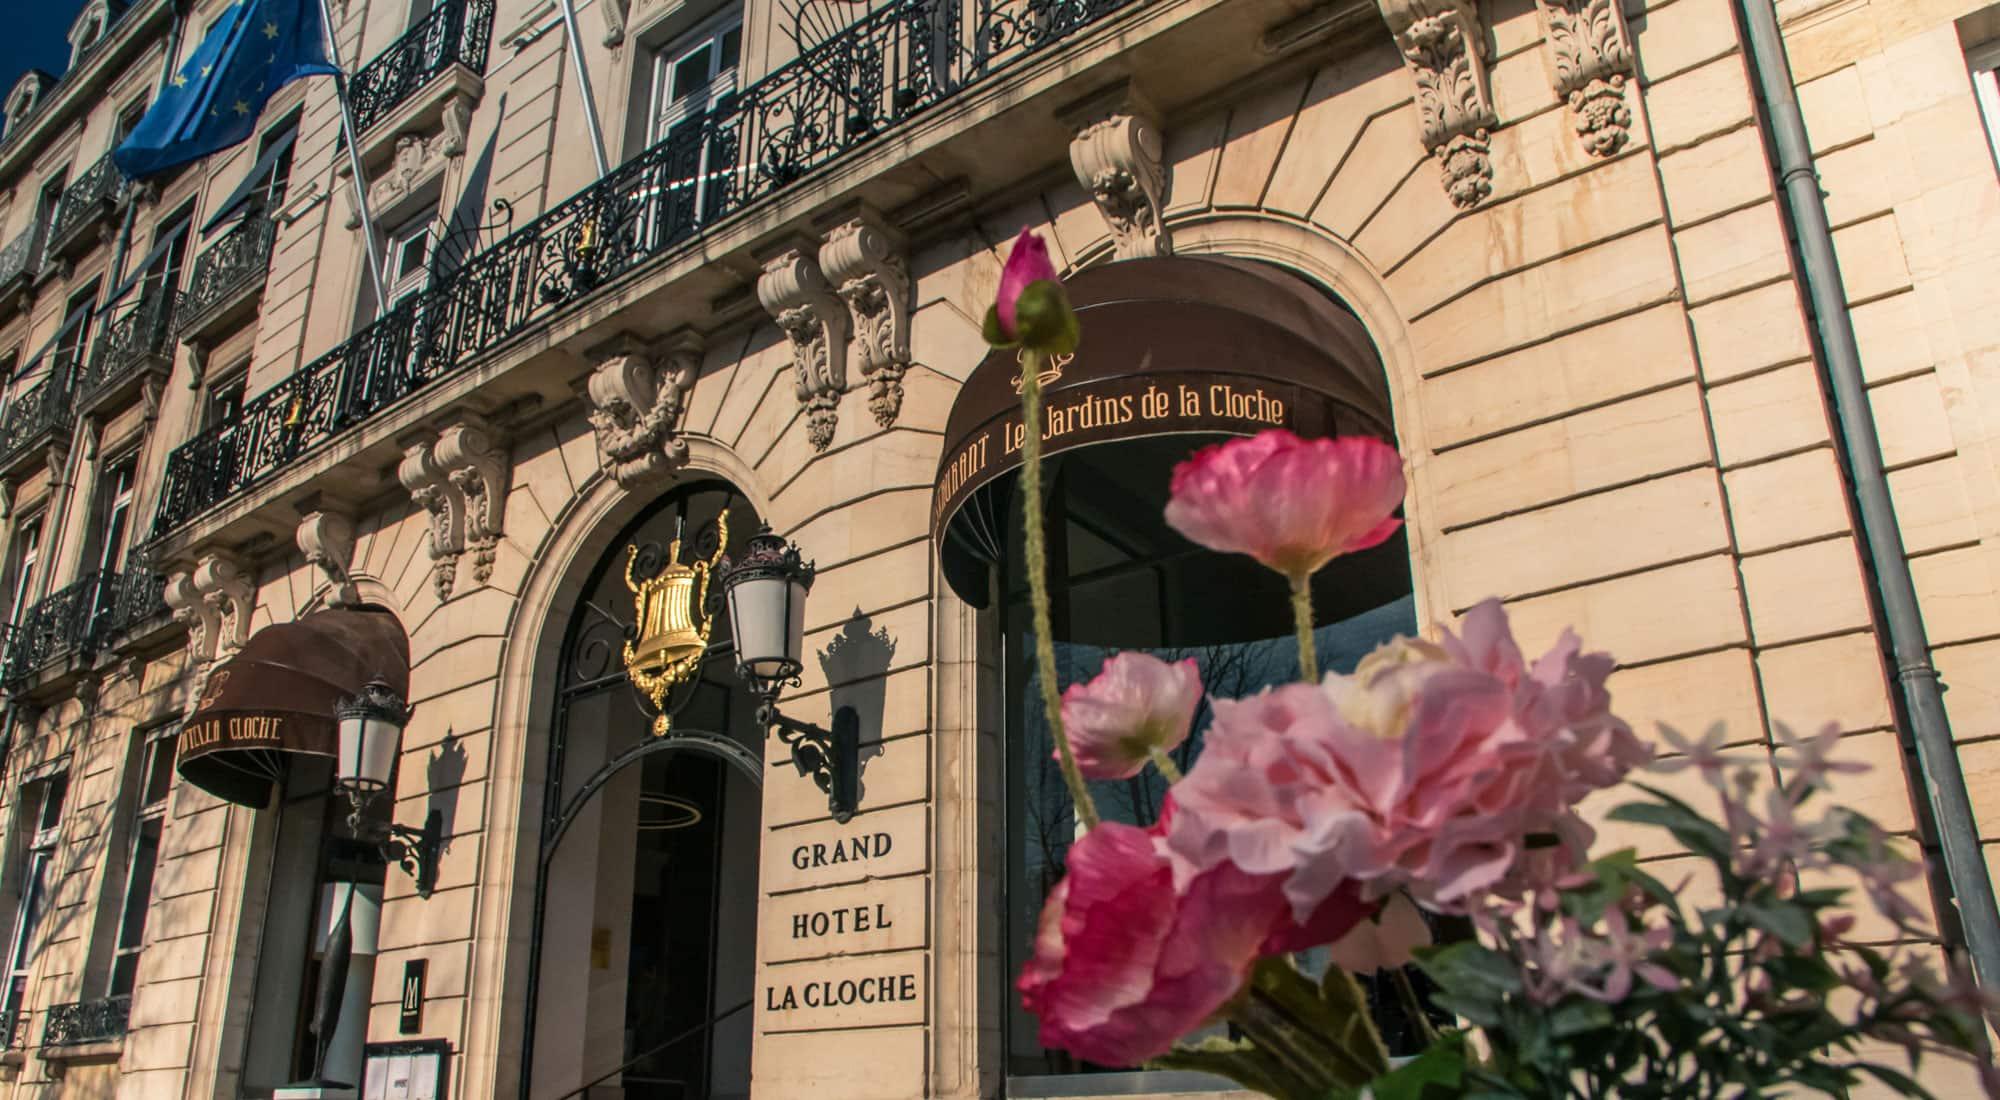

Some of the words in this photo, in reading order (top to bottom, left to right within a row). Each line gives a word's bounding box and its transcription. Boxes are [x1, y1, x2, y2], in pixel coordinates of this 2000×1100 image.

[1005, 421, 1028, 455] Le
[1042, 394, 1133, 440] Jardins
[1141, 385, 1169, 419] de
[1179, 385, 1201, 416] la
[1209, 384, 1284, 425] Cloche
[229, 716, 283, 740] CLOCHE
[792, 832, 892, 870] GRAND
[792, 903, 892, 939] HOTEL
[766, 985, 798, 1011] LA
[803, 973, 917, 1008] CLOCHE
